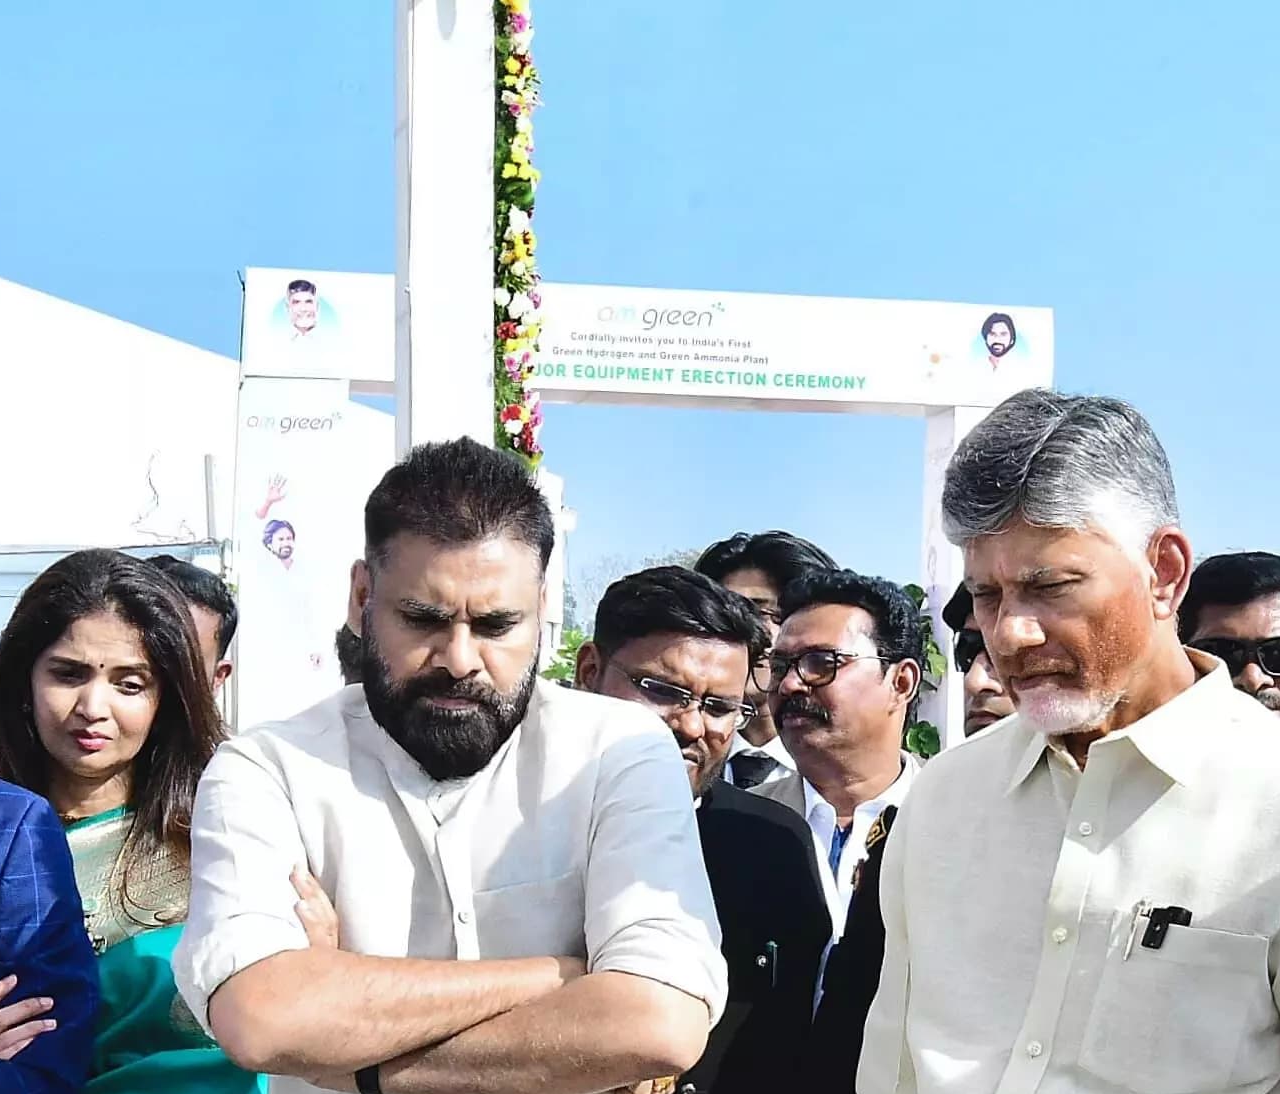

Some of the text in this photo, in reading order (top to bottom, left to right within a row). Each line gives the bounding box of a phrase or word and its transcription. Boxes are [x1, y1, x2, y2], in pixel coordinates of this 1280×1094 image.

[642, 308, 713, 331] green
[570, 332, 752, 349] Cordially invites you to India's First
[552, 346, 769, 366] Green Hydrogen and Green Ammonia Plant
[533, 363, 866, 390] JOR EQUIPMENT ERECTION CEREMONY
[280, 416, 334, 434] green
